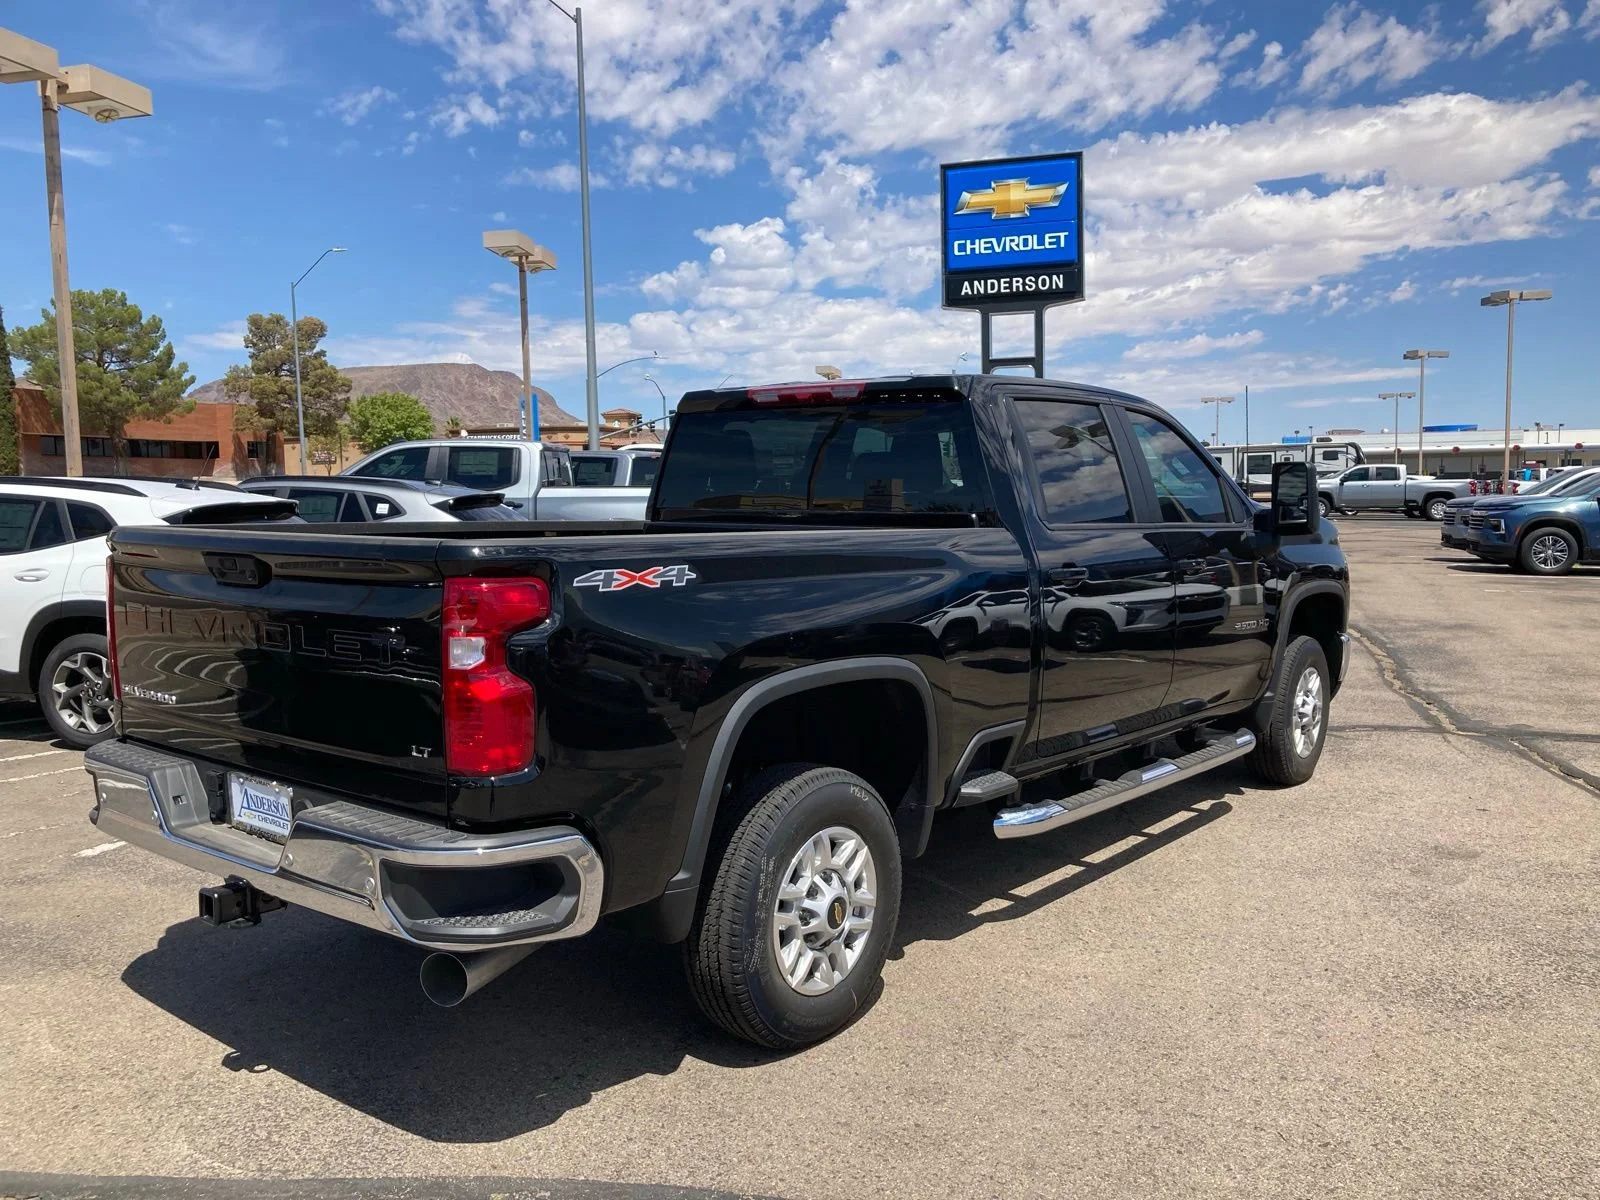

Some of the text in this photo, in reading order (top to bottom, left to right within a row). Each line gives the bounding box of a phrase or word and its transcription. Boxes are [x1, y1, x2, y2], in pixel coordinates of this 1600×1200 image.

[953, 231, 1069, 256] CHEVROLET
[960, 274, 1064, 296] ANDERSON
[122, 601, 406, 666] CHEVROLET
[121, 684, 177, 705] SILVERADO
[411, 745, 432, 759] LT
[238, 788, 290, 818] ANDERSON
[257, 815, 289, 831] CHEVROLET
